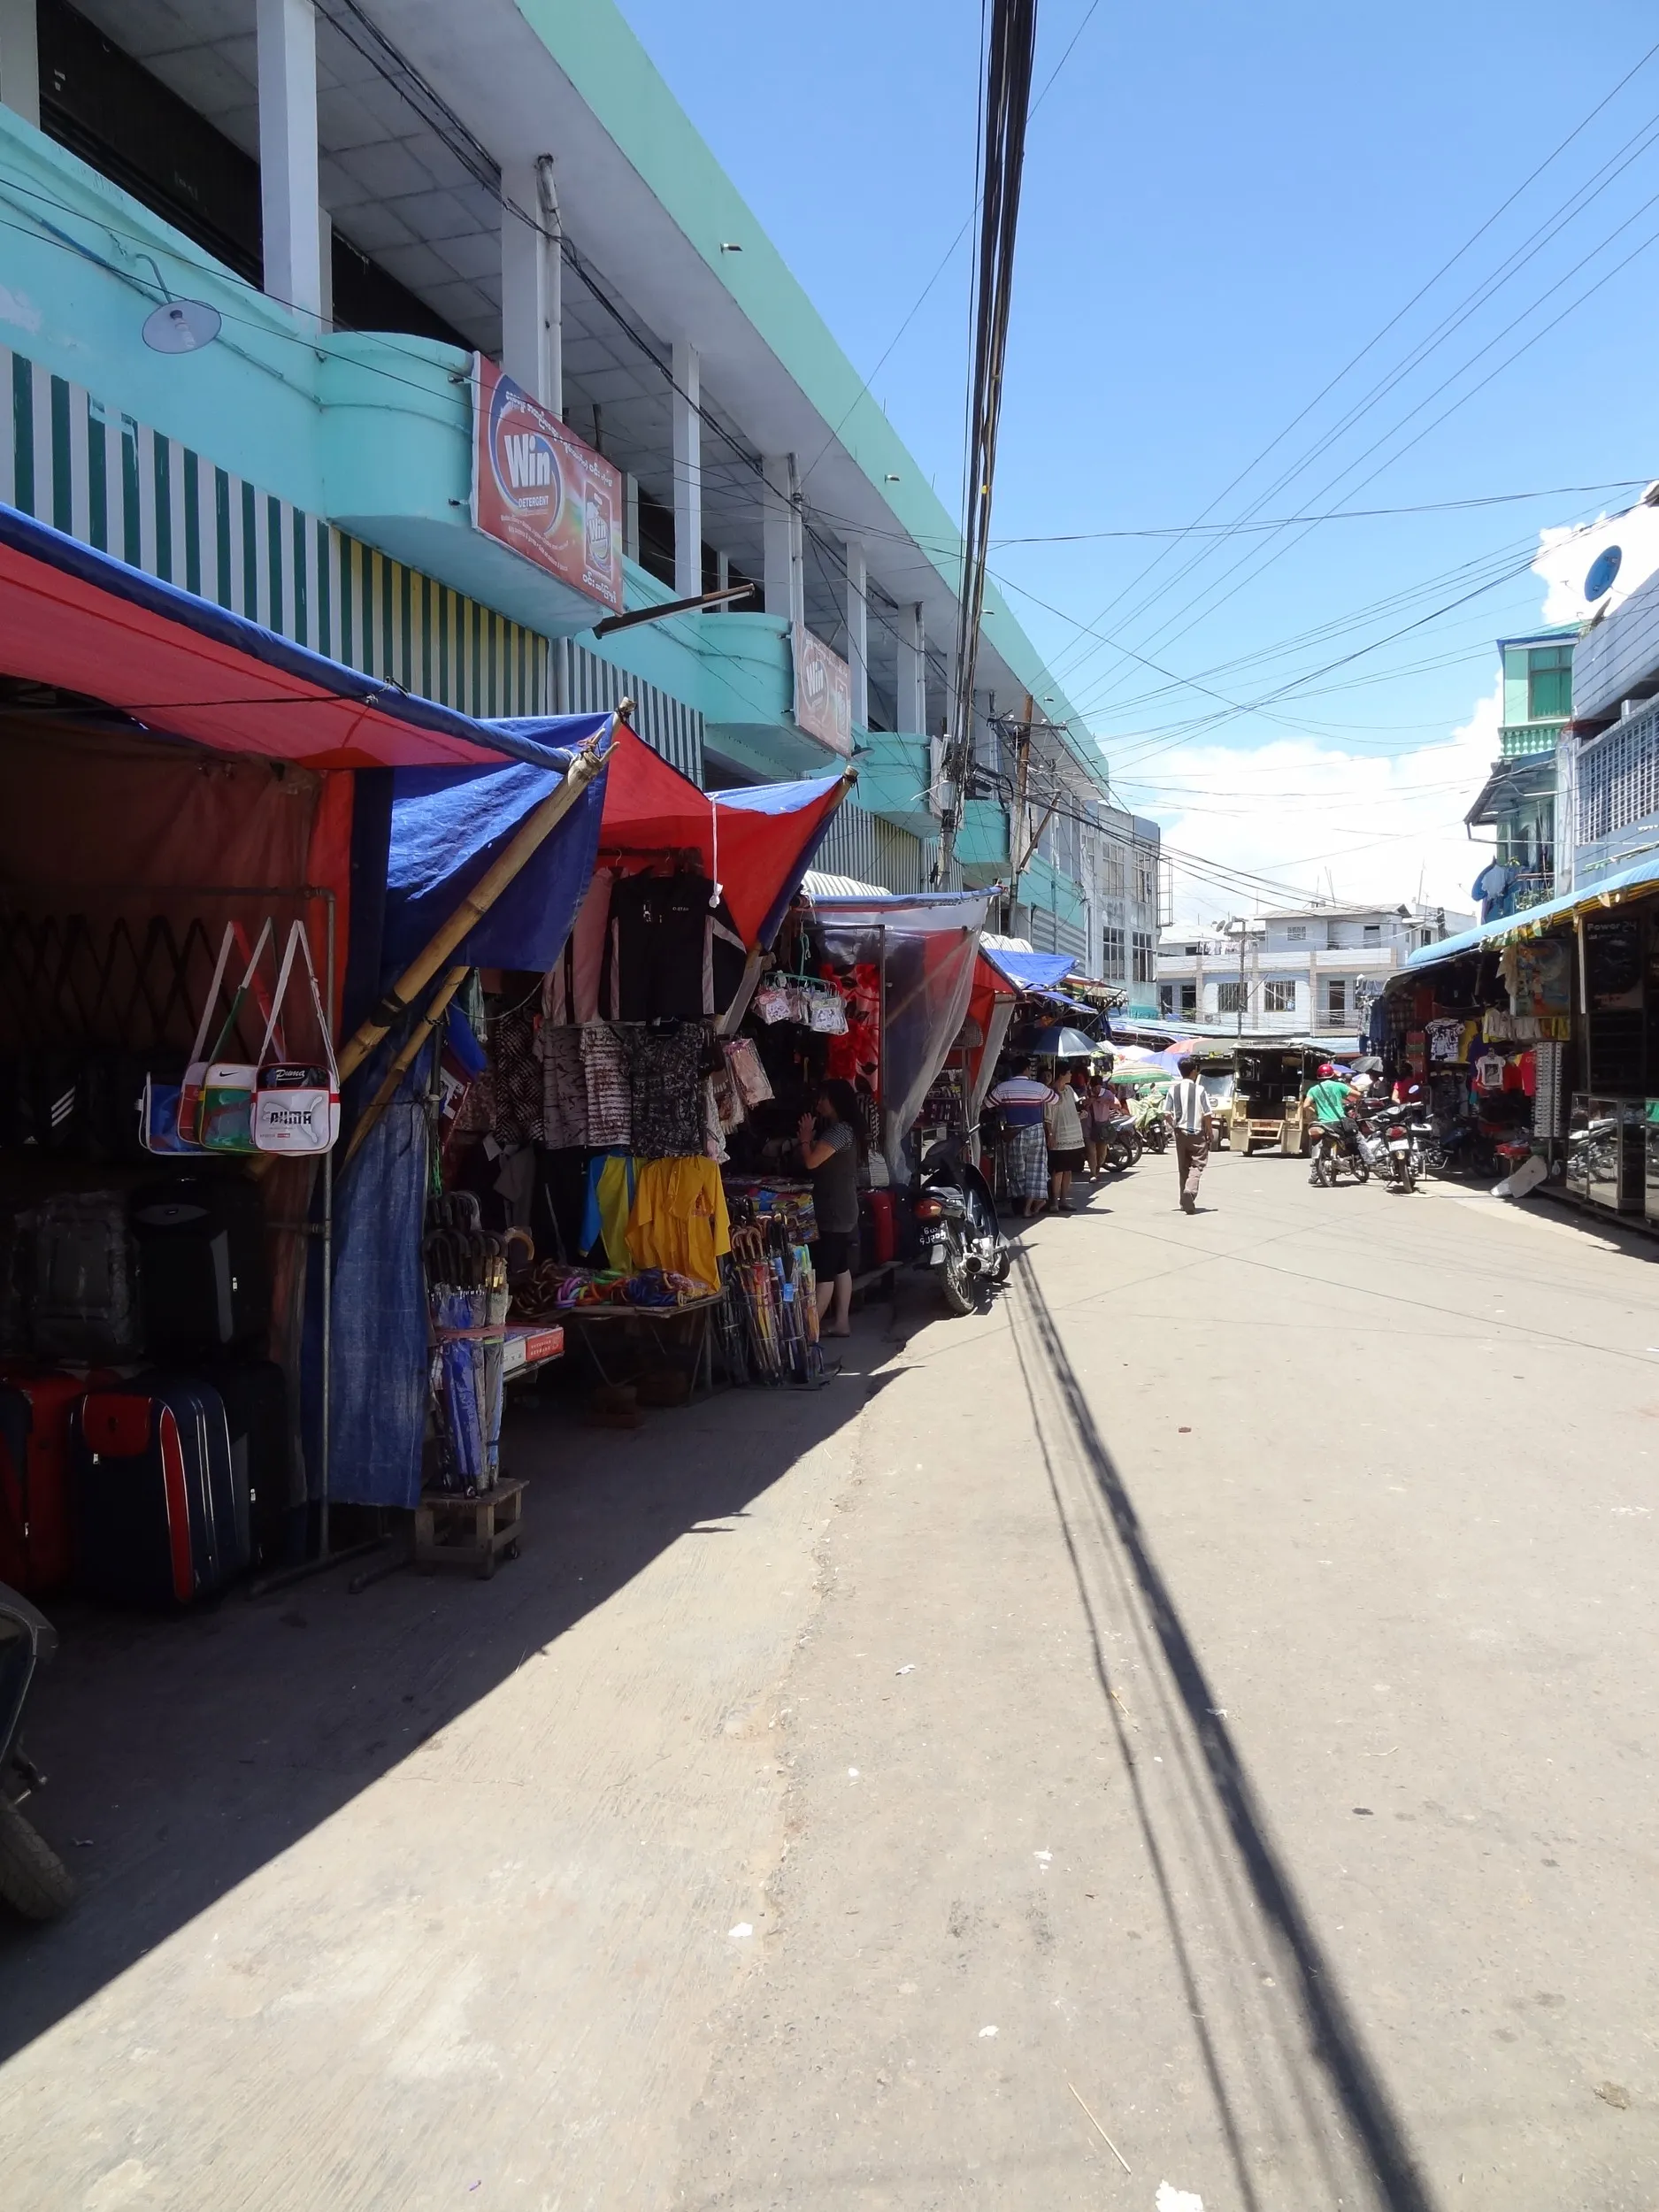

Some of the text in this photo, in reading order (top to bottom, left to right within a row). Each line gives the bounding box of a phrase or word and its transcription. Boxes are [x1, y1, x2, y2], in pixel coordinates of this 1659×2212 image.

[504, 433, 550, 488] Win
[518, 495, 549, 508] DETERGENT
[588, 517, 606, 542] Win
[806, 661, 823, 697] Win
[1586, 920, 1637, 933] Power 24
